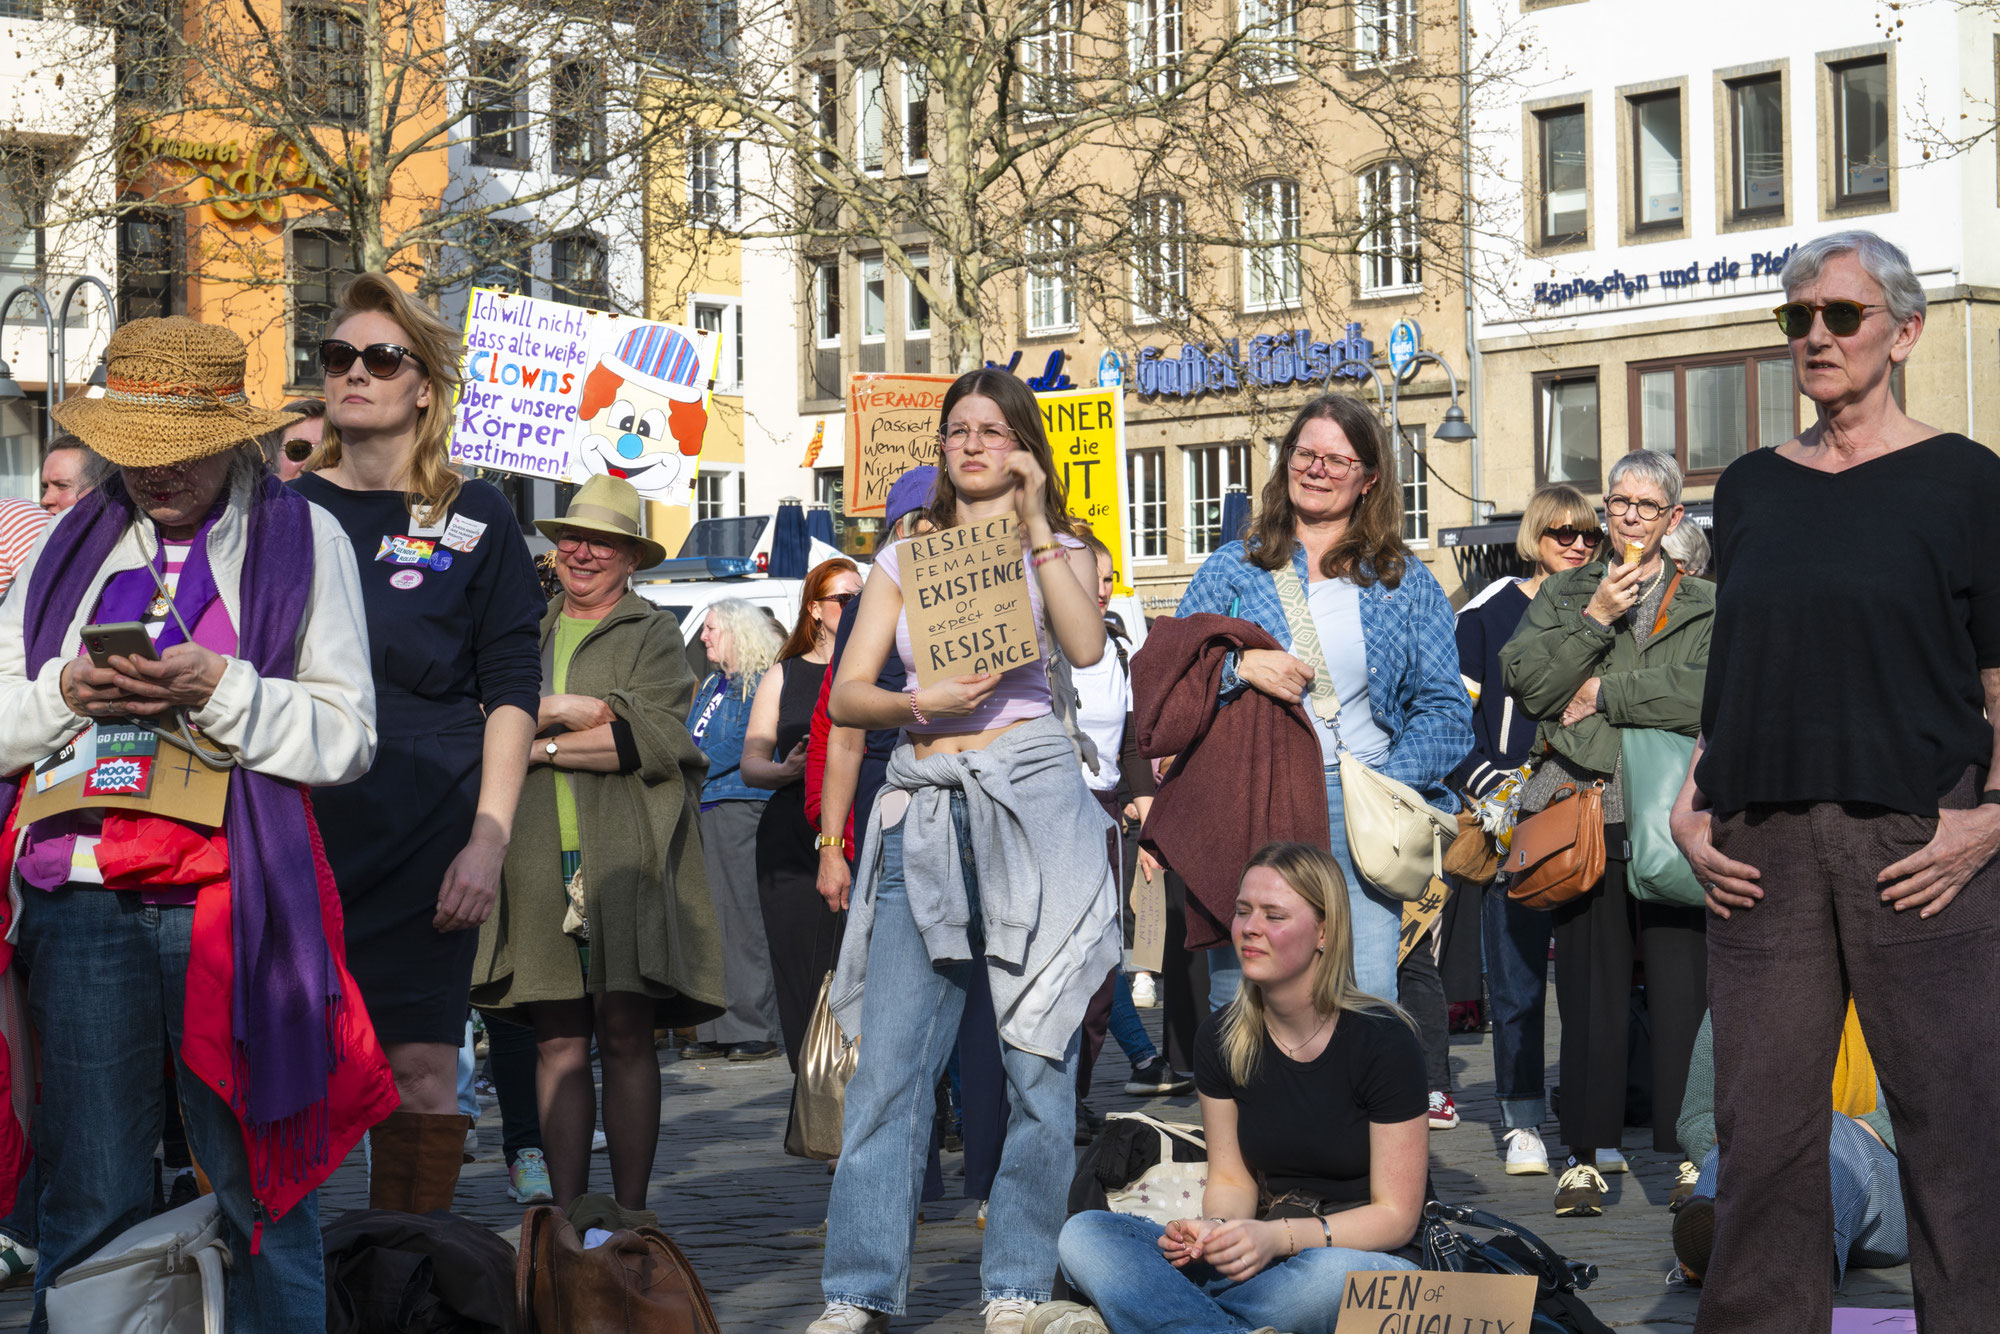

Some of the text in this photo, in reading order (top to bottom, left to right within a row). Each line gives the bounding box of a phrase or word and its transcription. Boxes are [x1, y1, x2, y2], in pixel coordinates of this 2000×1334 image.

[1660, 262, 1700, 287] und
[1708, 257, 1740, 283] die
[472, 293, 588, 340] Ich will nicht,
[468, 324, 586, 368] dass alte weiße
[461, 383, 577, 422] über unsere
[858, 385, 944, 412] VERÄNDE
[462, 408, 565, 447] Körper
[1040, 401, 1112, 432] NNER
[451, 434, 569, 475] bestimmen!
[1069, 436, 1099, 455] die
[1088, 503, 1110, 517] die
[396, 547, 417, 555] GENDER
[911, 518, 1010, 561] RESPECT
[915, 544, 1007, 581] FEMALE
[919, 558, 1024, 609] EXISTENCE
[928, 599, 1018, 633] expect our
[974, 641, 1034, 674] ANCE
[97, 733, 111, 743] GO
[112, 732, 134, 742] FOR
[138, 731, 154, 741] IT!
[1346, 1275, 1445, 1310] MEN of
